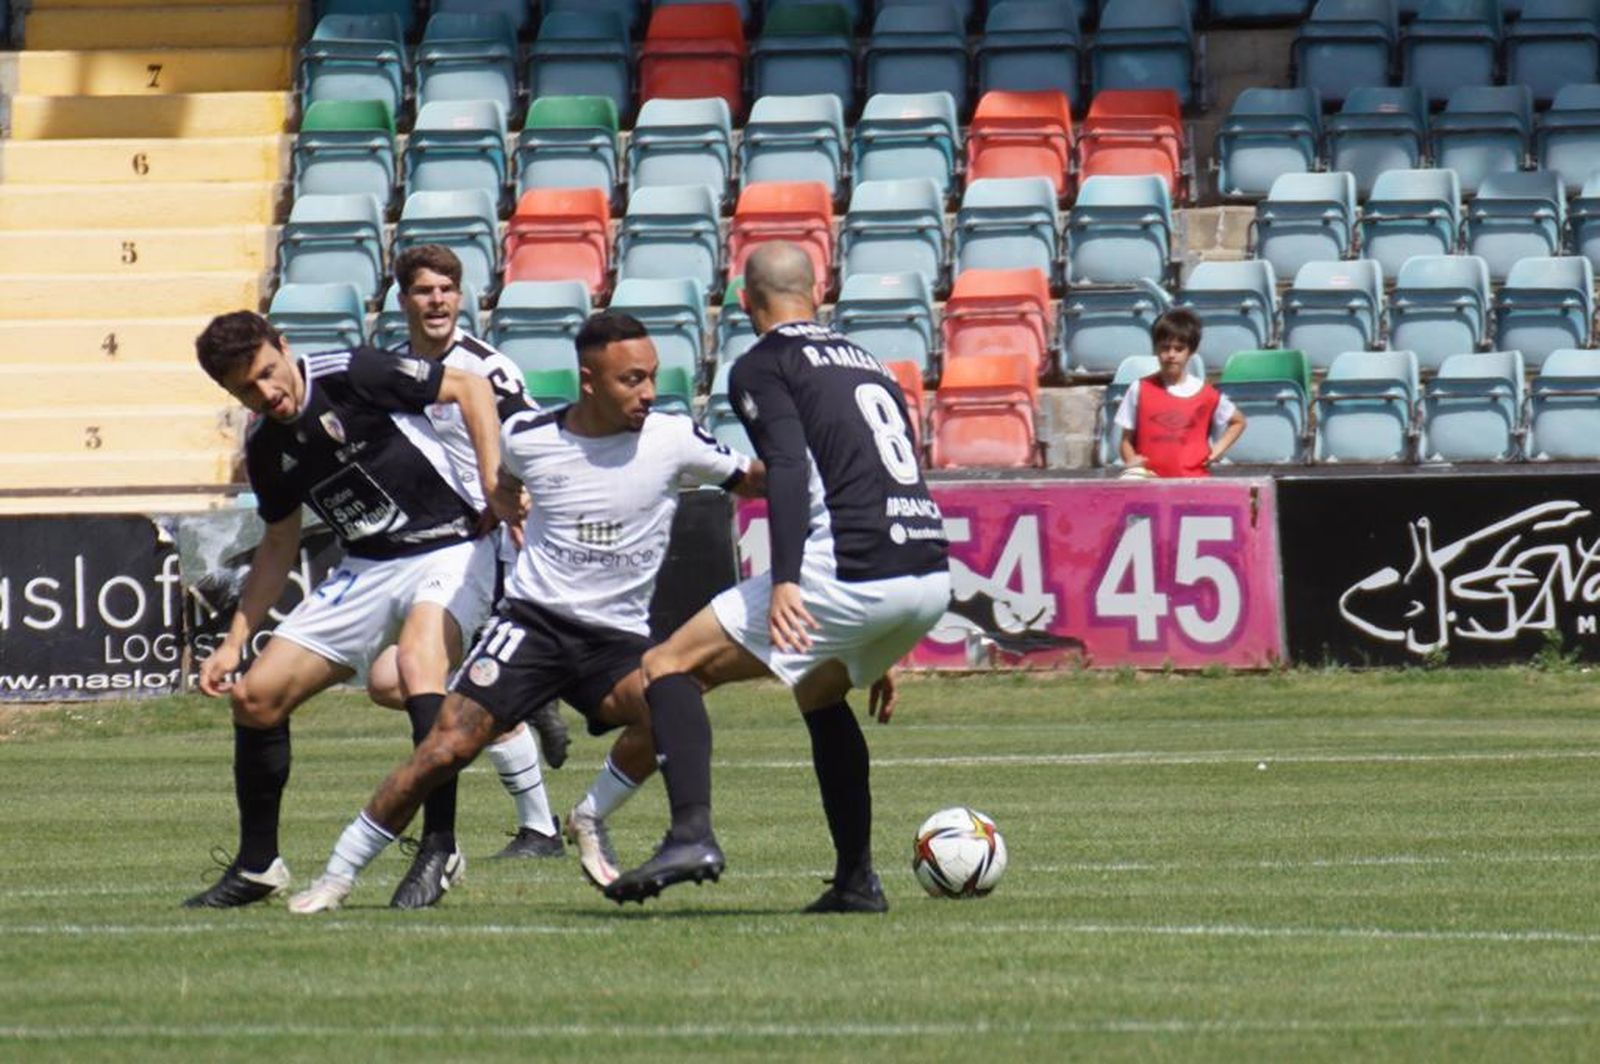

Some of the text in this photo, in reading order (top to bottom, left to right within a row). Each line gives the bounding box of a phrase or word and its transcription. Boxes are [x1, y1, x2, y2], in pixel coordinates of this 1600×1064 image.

[146, 64, 163, 88] 7
[132, 154, 150, 175] 6
[121, 242, 138, 264] 5
[101, 333, 119, 356] 4
[86, 426, 103, 449] 3
[855, 382, 919, 485] 8
[1095, 515, 1241, 644] 45
[486, 619, 527, 662] 11
